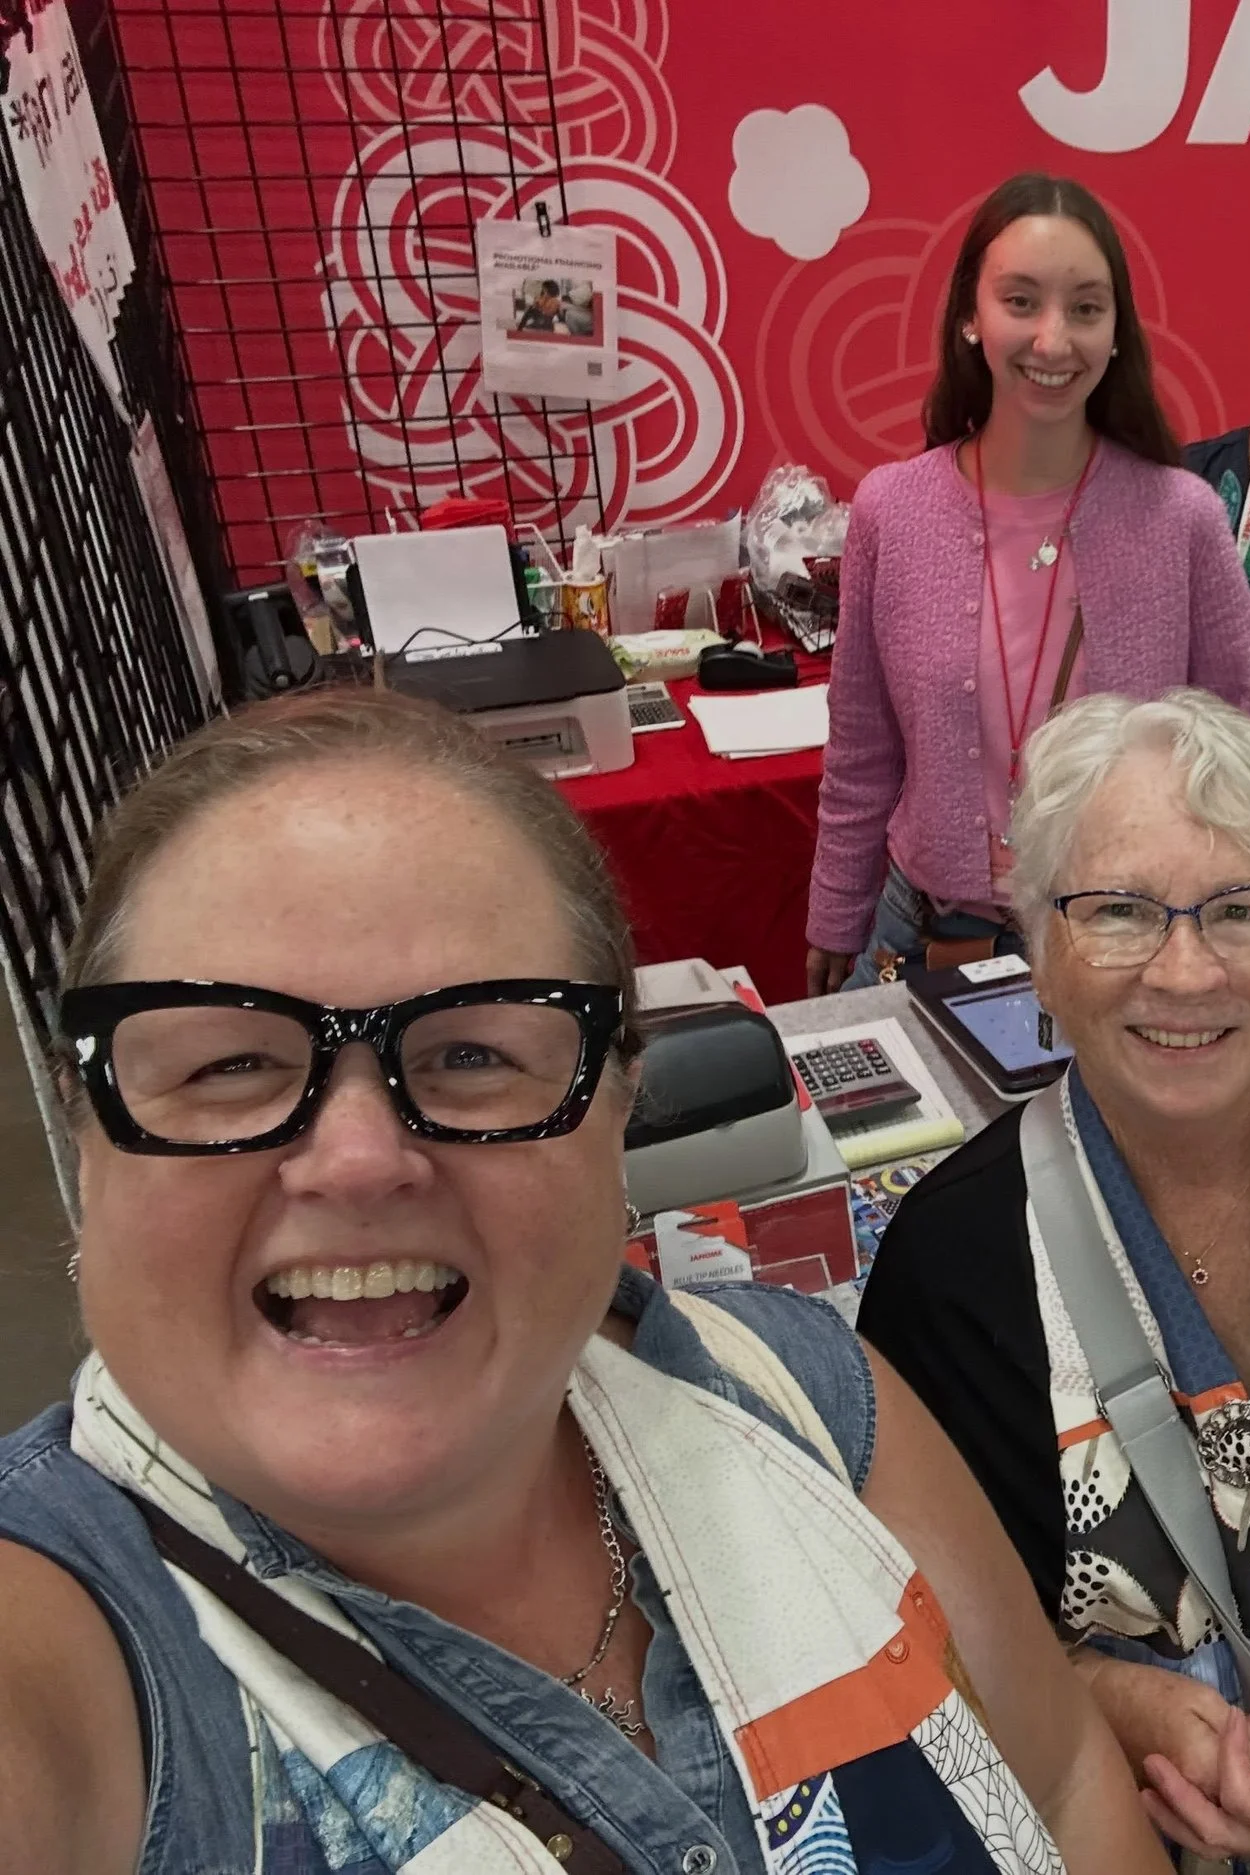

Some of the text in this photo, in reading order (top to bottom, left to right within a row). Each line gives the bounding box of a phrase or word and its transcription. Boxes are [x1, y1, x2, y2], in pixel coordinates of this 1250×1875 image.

[689, 1249, 723, 1262] JANOME
[695, 1270, 708, 1281] TIP
[708, 1263, 744, 1278] NEEDLES
